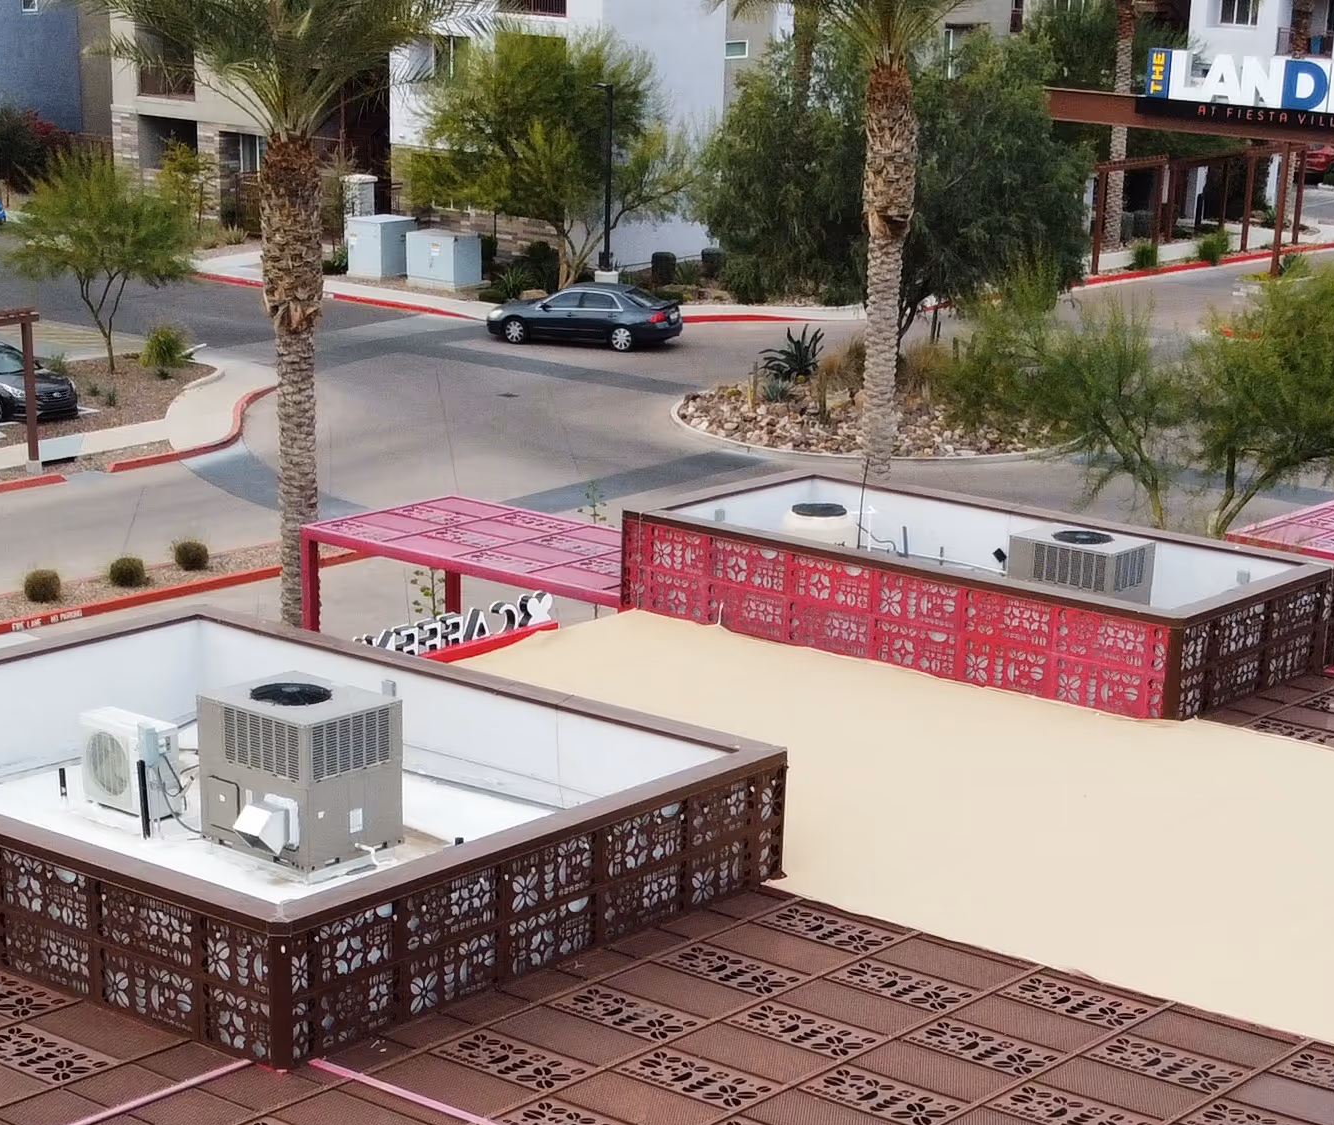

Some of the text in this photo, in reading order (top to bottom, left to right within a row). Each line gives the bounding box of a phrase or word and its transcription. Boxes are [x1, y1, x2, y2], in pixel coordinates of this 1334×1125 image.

[1150, 52, 1165, 94] THE
[1197, 105, 1216, 117] AT
[1226, 108, 1288, 123] FIESTA
